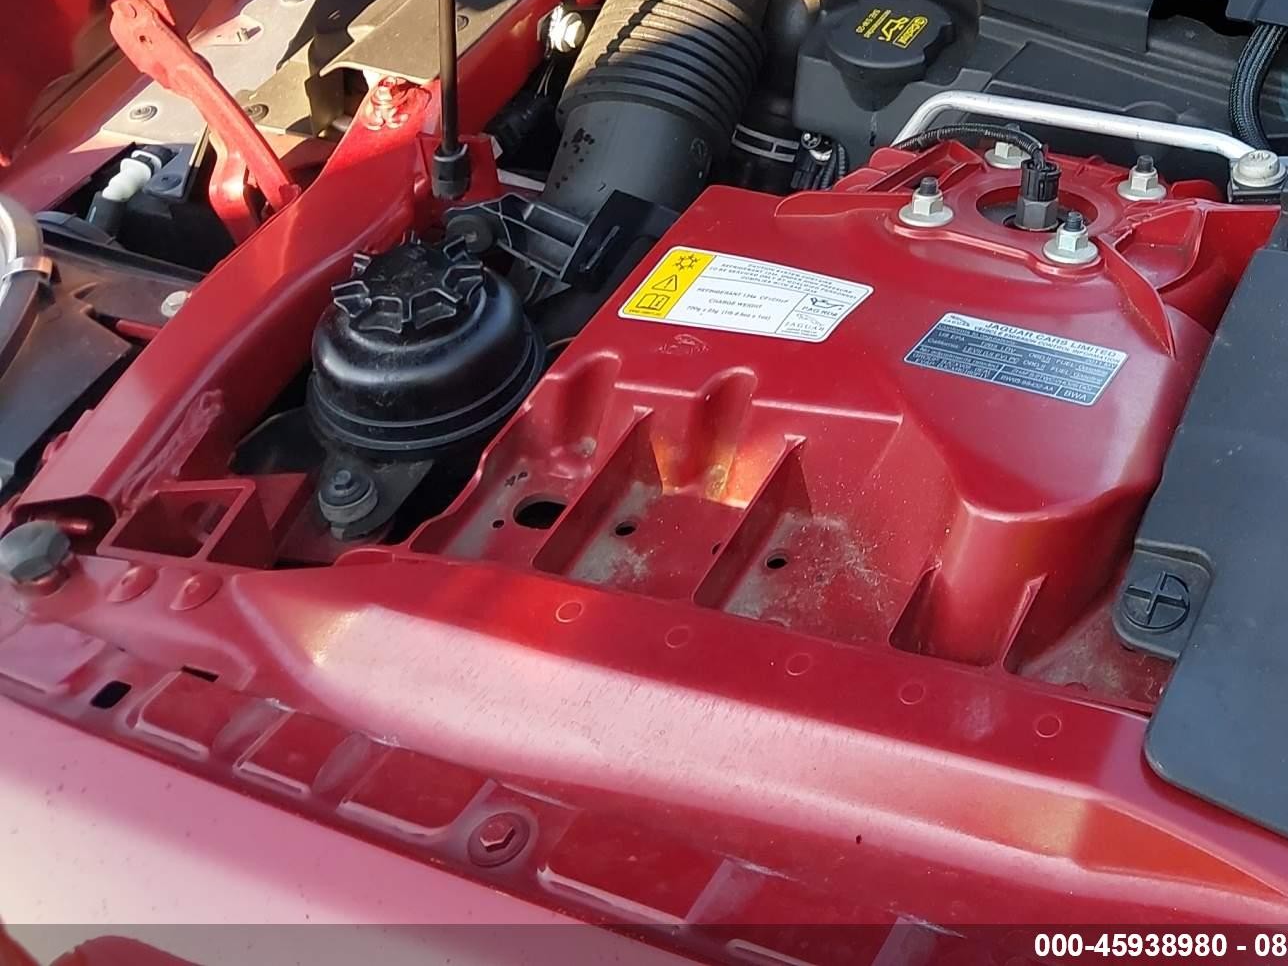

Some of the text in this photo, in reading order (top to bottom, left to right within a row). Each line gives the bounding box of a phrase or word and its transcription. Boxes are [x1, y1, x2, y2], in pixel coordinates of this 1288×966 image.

[985, 322, 1116, 356] JAGUAR CARS LIMITED
[1063, 389, 1088, 400] BWA
